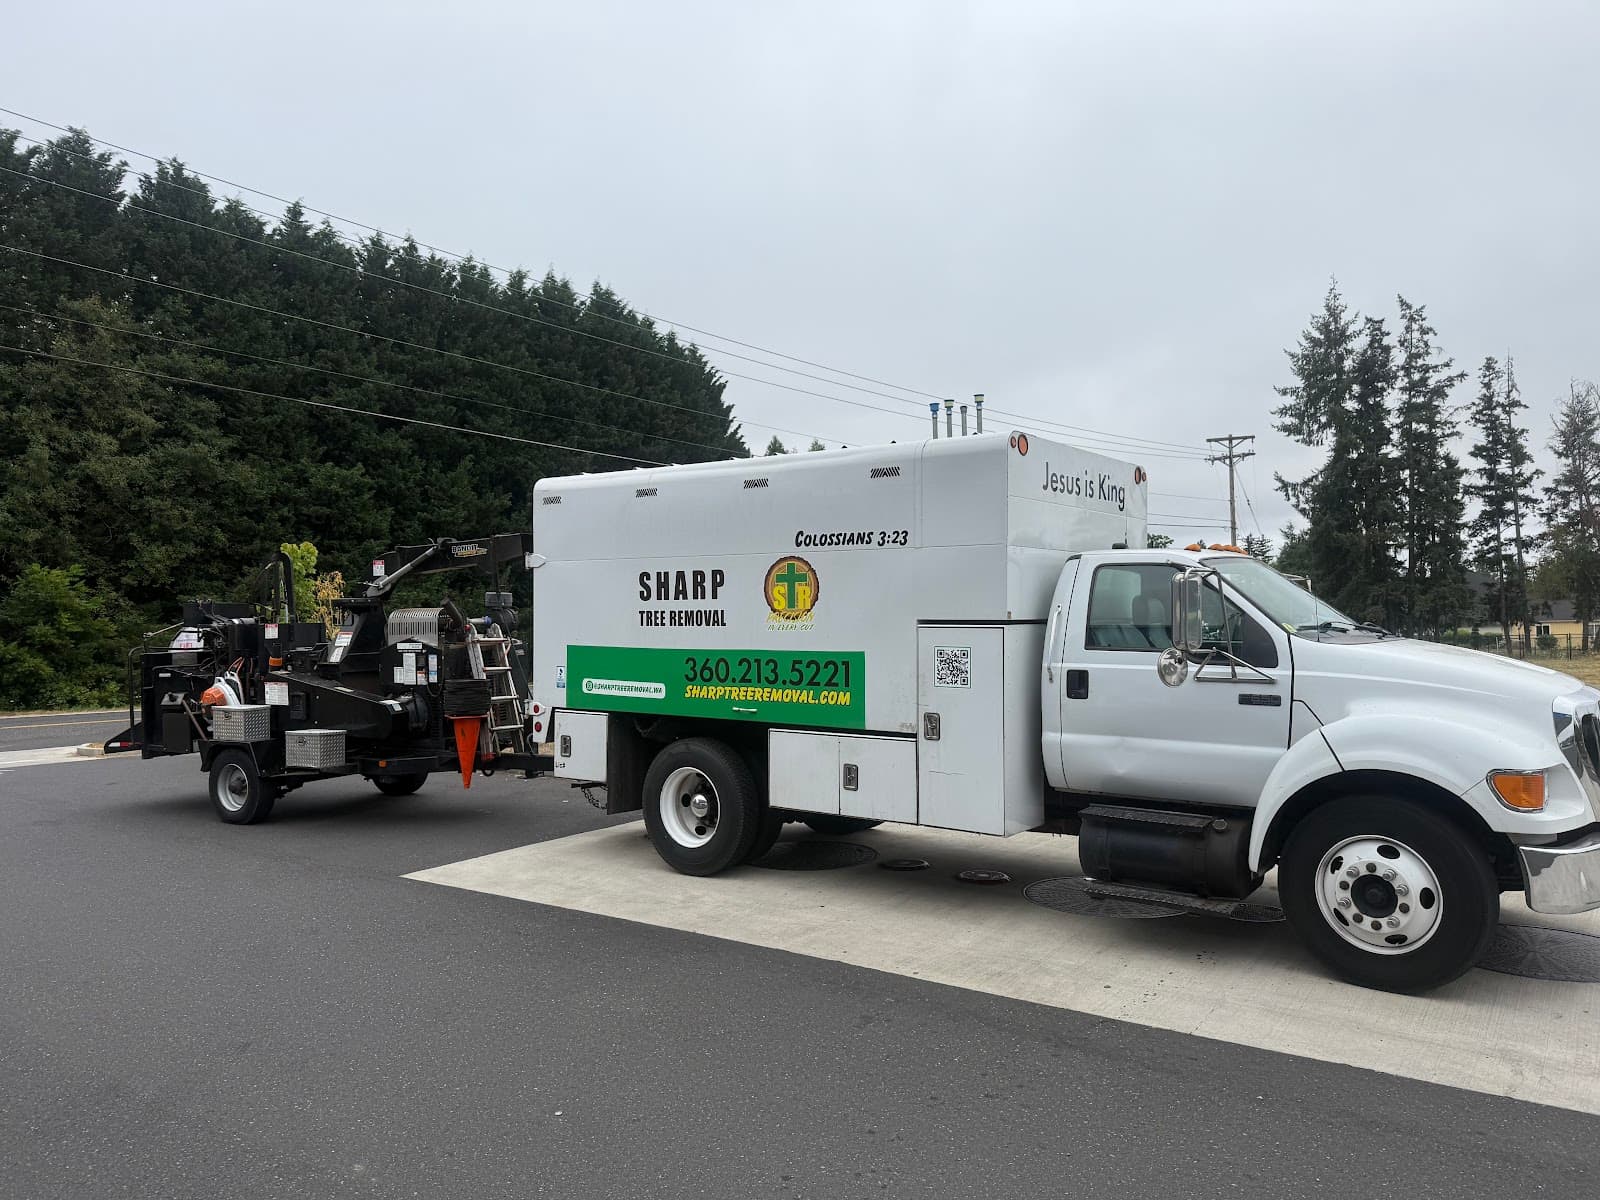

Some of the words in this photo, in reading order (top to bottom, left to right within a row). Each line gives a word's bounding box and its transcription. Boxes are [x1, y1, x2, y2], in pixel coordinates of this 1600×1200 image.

[1043, 461, 1081, 496] Jesus
[1084, 469, 1095, 498] is
[1098, 472, 1125, 512] King
[877, 529, 909, 547] 3:23
[638, 569, 726, 602] SHARP
[638, 610, 666, 627] TREE
[669, 609, 727, 627] REMOVAL
[683, 656, 851, 688] 360.213.5221
[684, 684, 851, 706] SHARPTREEREMOVAL.COM
